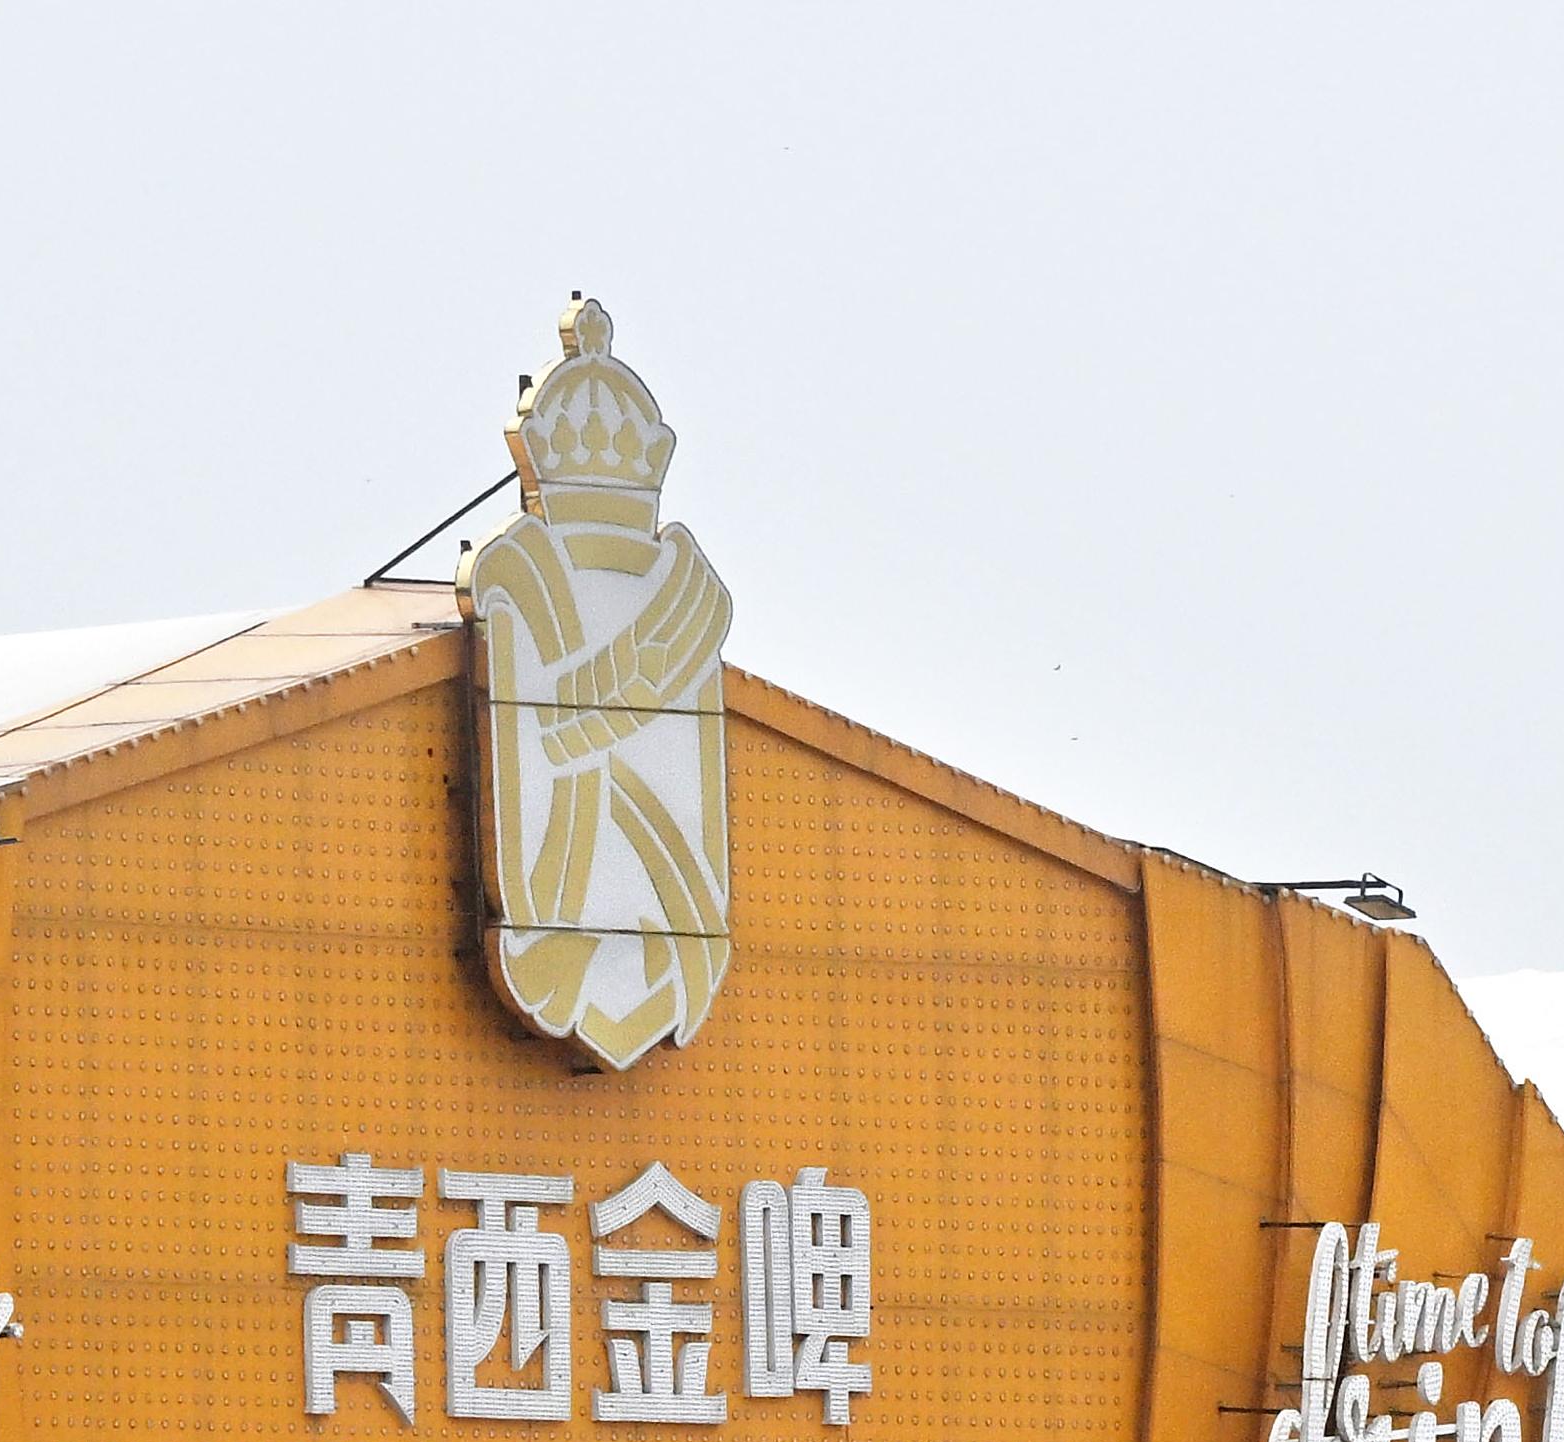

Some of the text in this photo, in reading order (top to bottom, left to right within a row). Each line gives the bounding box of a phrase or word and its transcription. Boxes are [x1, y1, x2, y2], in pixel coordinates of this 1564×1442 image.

[286, 1151, 871, 1427] 青西金啤
[1351, 1223, 1558, 1376] time to
